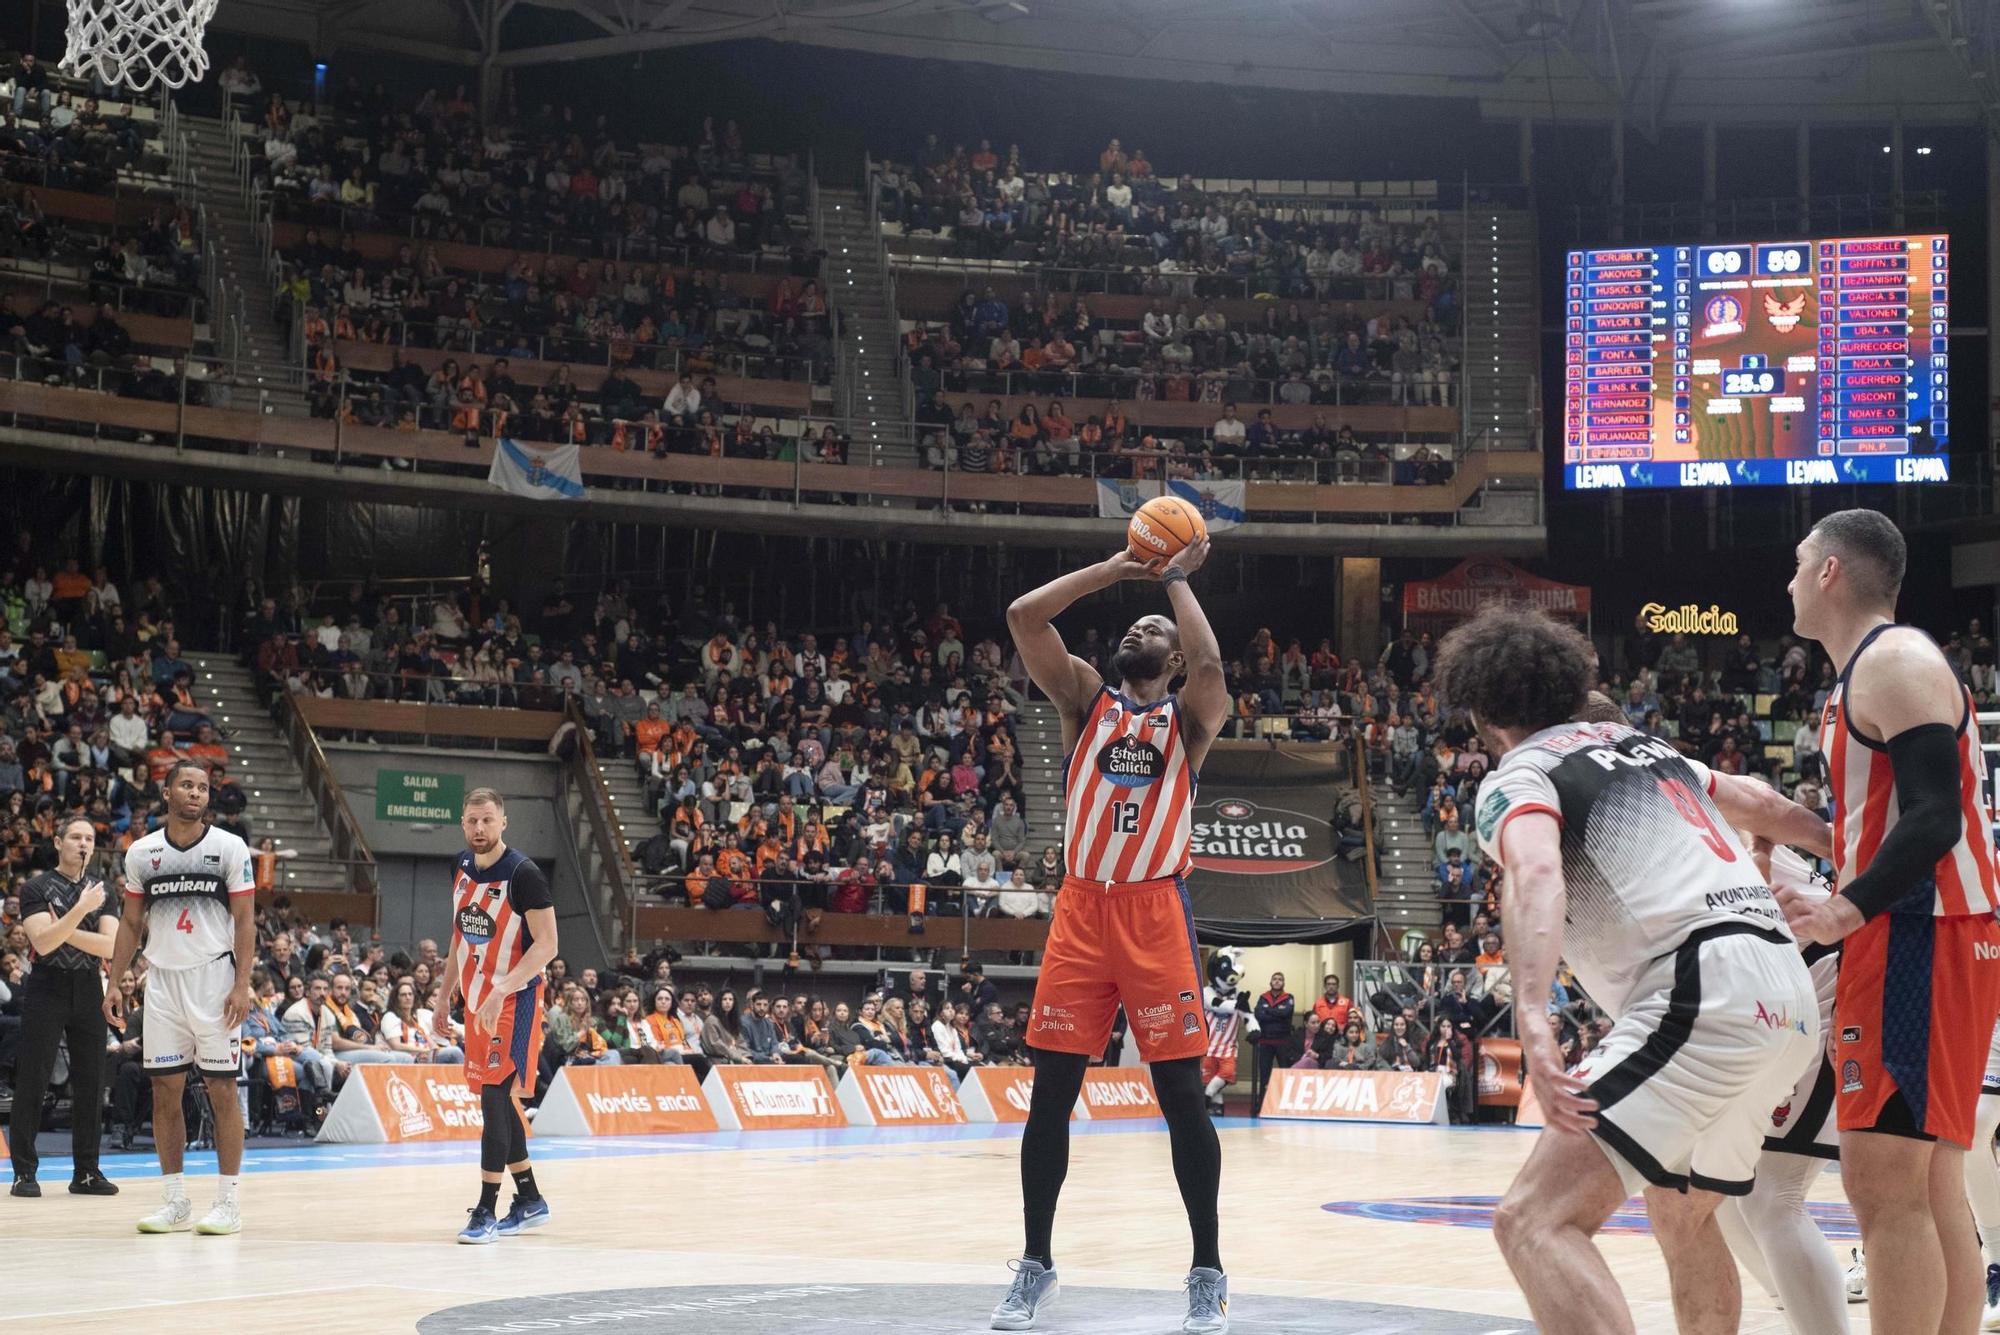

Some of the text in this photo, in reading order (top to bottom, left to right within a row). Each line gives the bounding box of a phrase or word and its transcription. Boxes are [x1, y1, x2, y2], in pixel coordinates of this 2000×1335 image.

[1845, 242, 1901, 252] ROUSSELLE
[1936, 240, 1942, 250] 7
[1708, 251, 1741, 274] 69
[1768, 250, 1800, 272] 59
[1598, 270, 1642, 279] JAKOVICS
[1844, 276, 1902, 285] BEZHANISHV
[1594, 302, 1644, 312] LUNDQVIST
[1848, 309, 1898, 318] VALTONEN
[1572, 320, 1580, 328] 11
[1571, 336, 1580, 344] 12
[1678, 348, 1687, 358] 11
[1840, 342, 1907, 352] AURRECOECH
[1570, 354, 1580, 362] 22
[1823, 360, 1832, 368] 17
[1934, 357, 1944, 367] 11
[1596, 367, 1643, 376] BARRUETA
[1726, 372, 1774, 393] 25.9
[1846, 376, 1901, 385] GUERRERO
[1592, 399, 1646, 408] HERNANDEZ
[1851, 393, 1896, 402] VISCONTI
[1592, 415, 1646, 425] THOMPKINS
[1590, 432, 1648, 441] BURJANADZE
[1852, 426, 1895, 435] SILVERIO
[1570, 434, 1579, 442] 77
[1576, 464, 1626, 488] LEYMA
[1680, 462, 1732, 486] LEYMA
[1786, 460, 1838, 484] LEYMA
[1896, 458, 1948, 482] LEYMA
[1640, 602, 1738, 635] Galicia
[1109, 746, 1154, 762] Estrella
[1110, 760, 1152, 775] Galicia
[403, 775, 439, 789] SALIDA
[414, 791, 427, 803] DE
[387, 804, 452, 820] EMERGENCIA
[1112, 800, 1140, 835] 12
[1656, 777, 1737, 863] 9
[1191, 820, 1308, 840] strella
[176, 906, 194, 934] 4
[1138, 1004, 1172, 1017] A Coruña
[1034, 1020, 1075, 1032] galicia
[586, 1087, 702, 1114] Nordés ancín
[866, 1074, 939, 1119] LEYMA
[1278, 1076, 1379, 1113] LEYMA
